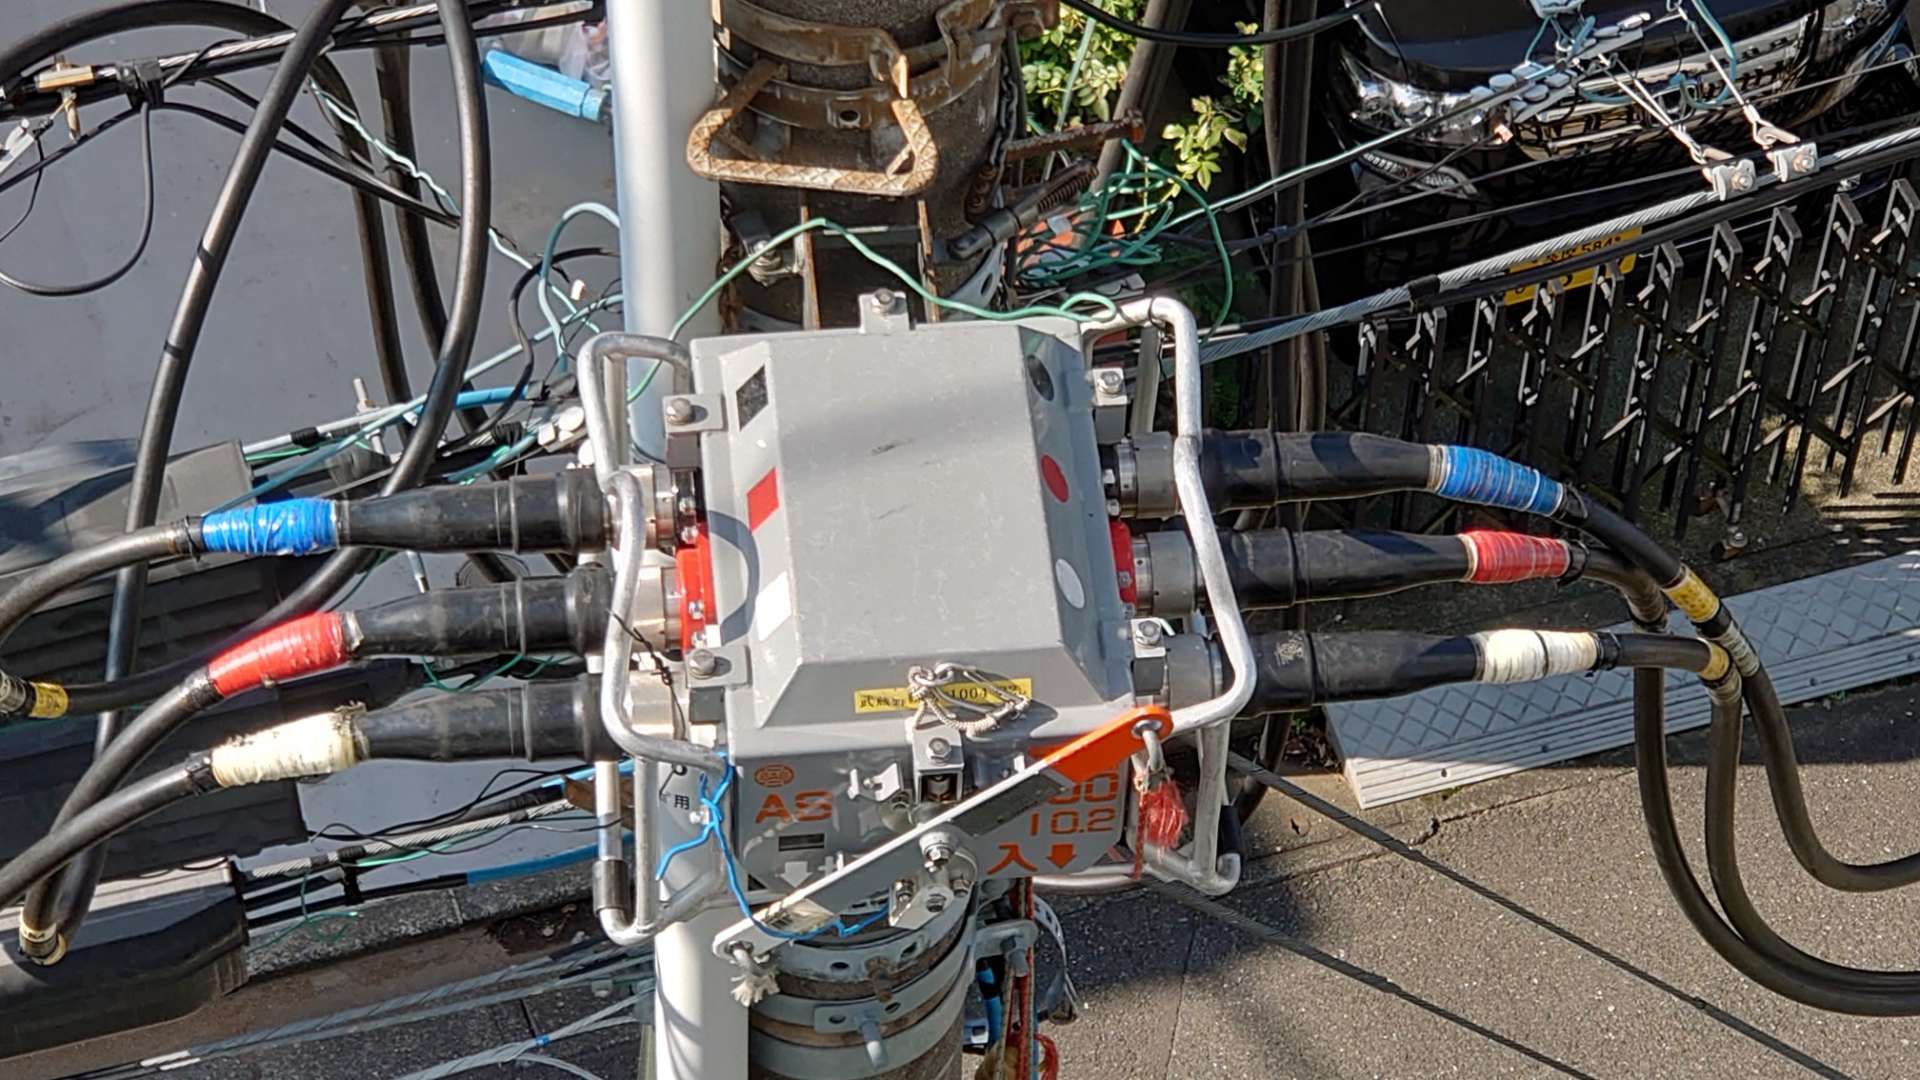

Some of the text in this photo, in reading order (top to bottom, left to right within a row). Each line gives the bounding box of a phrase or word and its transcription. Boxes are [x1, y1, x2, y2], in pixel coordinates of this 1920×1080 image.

[755, 790, 833, 824] AS
[1030, 807, 1117, 836] 10.2
[986, 841, 1038, 876] 入
